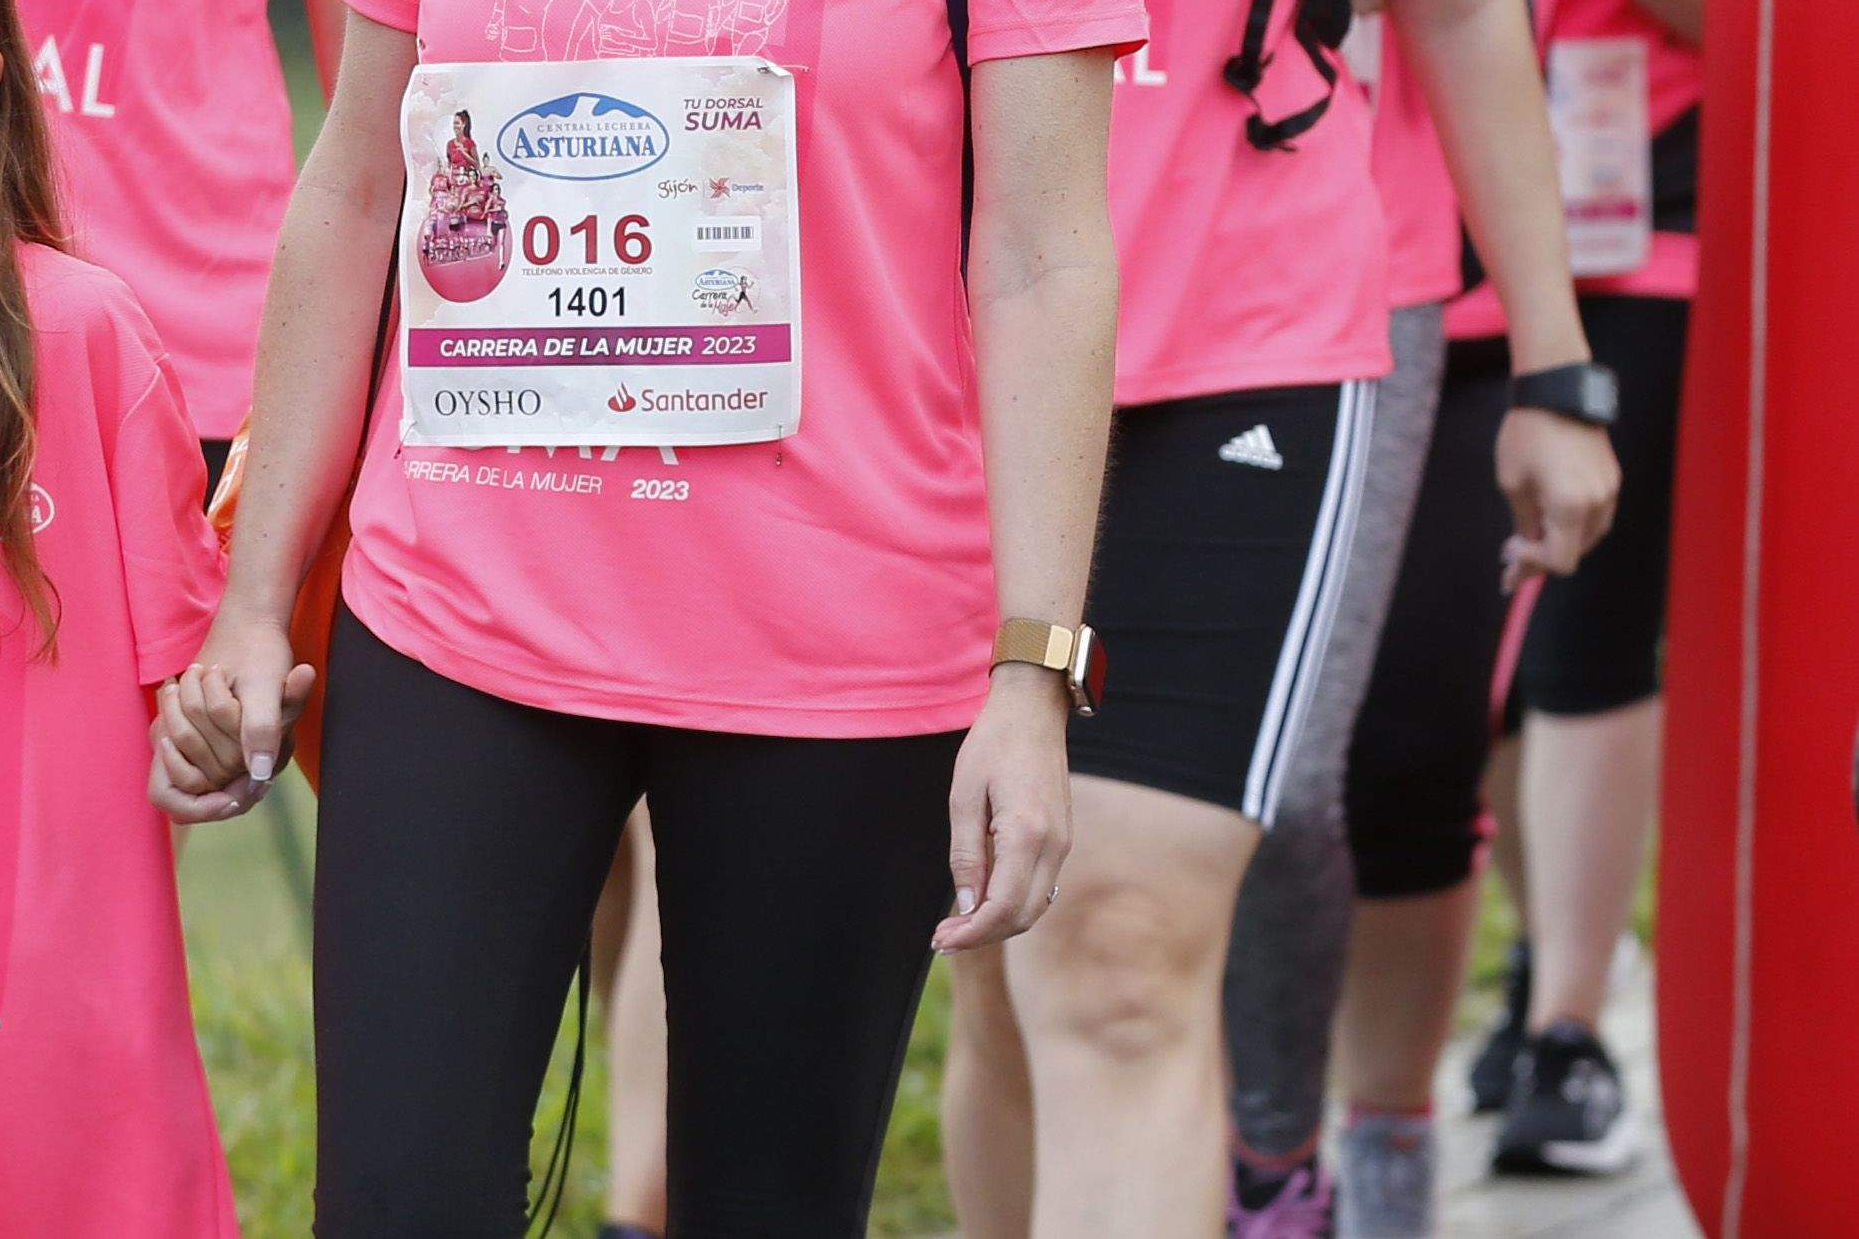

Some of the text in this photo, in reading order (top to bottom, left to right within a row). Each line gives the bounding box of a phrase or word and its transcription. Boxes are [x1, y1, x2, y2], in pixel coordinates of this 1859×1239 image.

[683, 97, 764, 110] TU DORSAL
[537, 121, 651, 132] CENTRAL LECHERA
[684, 111, 763, 131] SUMA
[512, 127, 658, 159] ASTURIANA
[522, 214, 653, 266] 016
[565, 267, 607, 276] VIOLENCIA
[608, 267, 619, 275] DE
[548, 286, 626, 317] 1401
[440, 336, 757, 358] CARRERA DE LA MUJER 2023
[435, 389, 541, 417] OYSHO
[641, 388, 768, 412] Santander
[475, 465, 500, 486] DE
[502, 468, 525, 490] LA
[531, 472, 603, 494] MUJER
[631, 479, 690, 501] 2023
